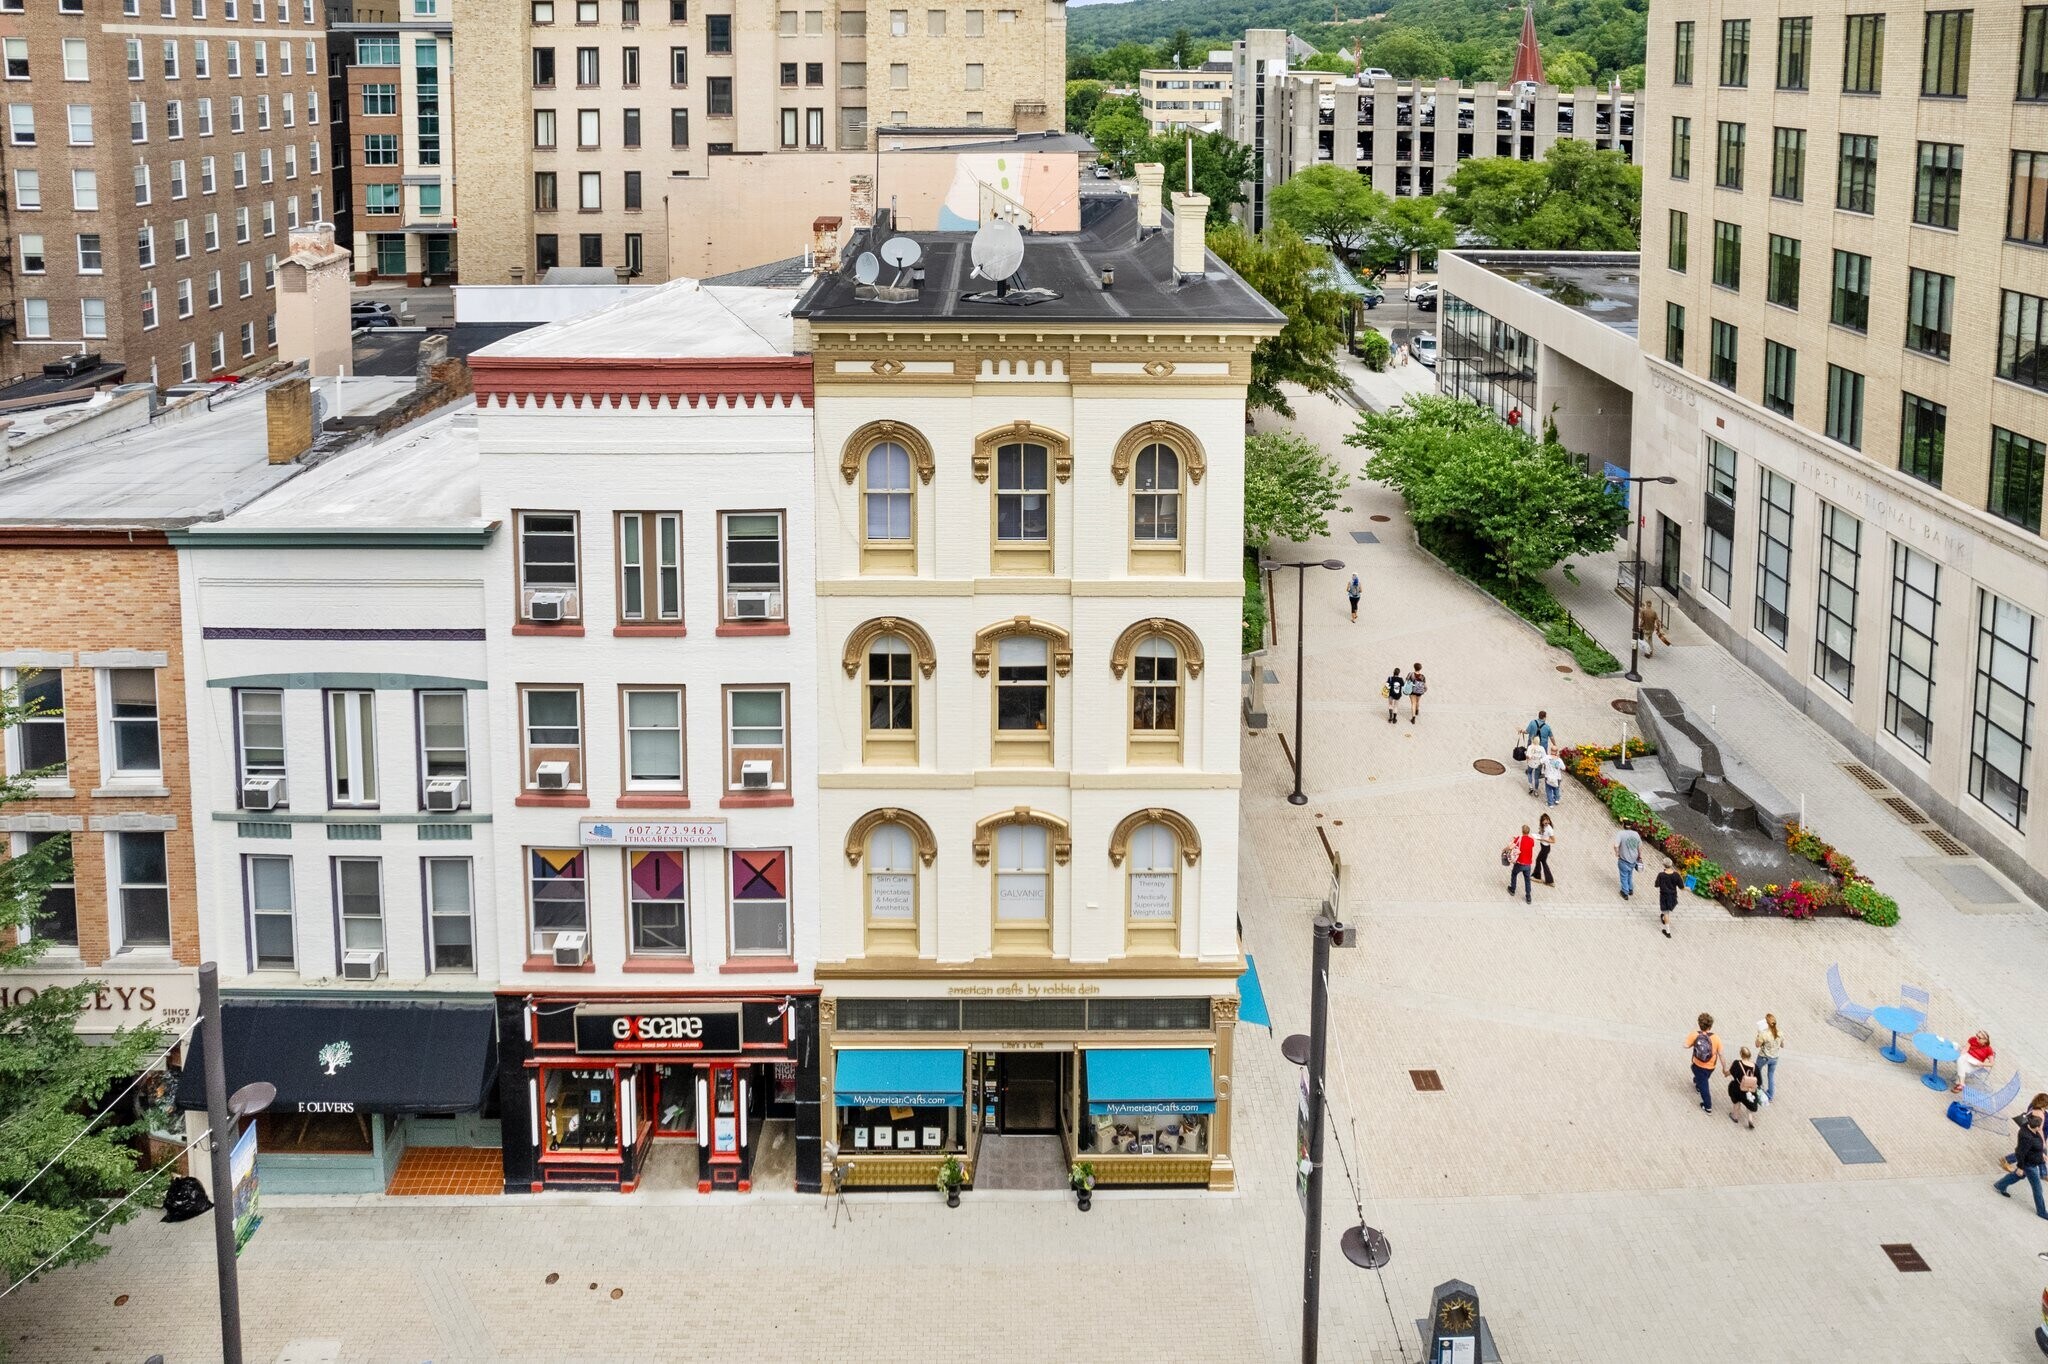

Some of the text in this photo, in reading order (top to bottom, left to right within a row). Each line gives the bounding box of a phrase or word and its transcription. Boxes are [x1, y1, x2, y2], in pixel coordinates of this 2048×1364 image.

[1802, 461, 1966, 557] FIRST NATIONAL BANK
[628, 826, 714, 835] 607.273.9462
[876, 875, 891, 883] Skin
[1139, 880, 1166, 888] Therapy
[874, 888, 911, 896] Injectables
[1000, 888, 1044, 898] GALVANIC
[1132, 909, 1155, 917] Weight
[948, 981, 1100, 997] american crafts by robbie dein
[0, 986, 156, 1011] HOEYS
[162, 1008, 190, 1016] SINCE
[853, 1094, 946, 1105] MyAmericanCrafts.com
[298, 1101, 306, 1113] F.
[1106, 1102, 1199, 1114] MyAmericanCrafts.com
